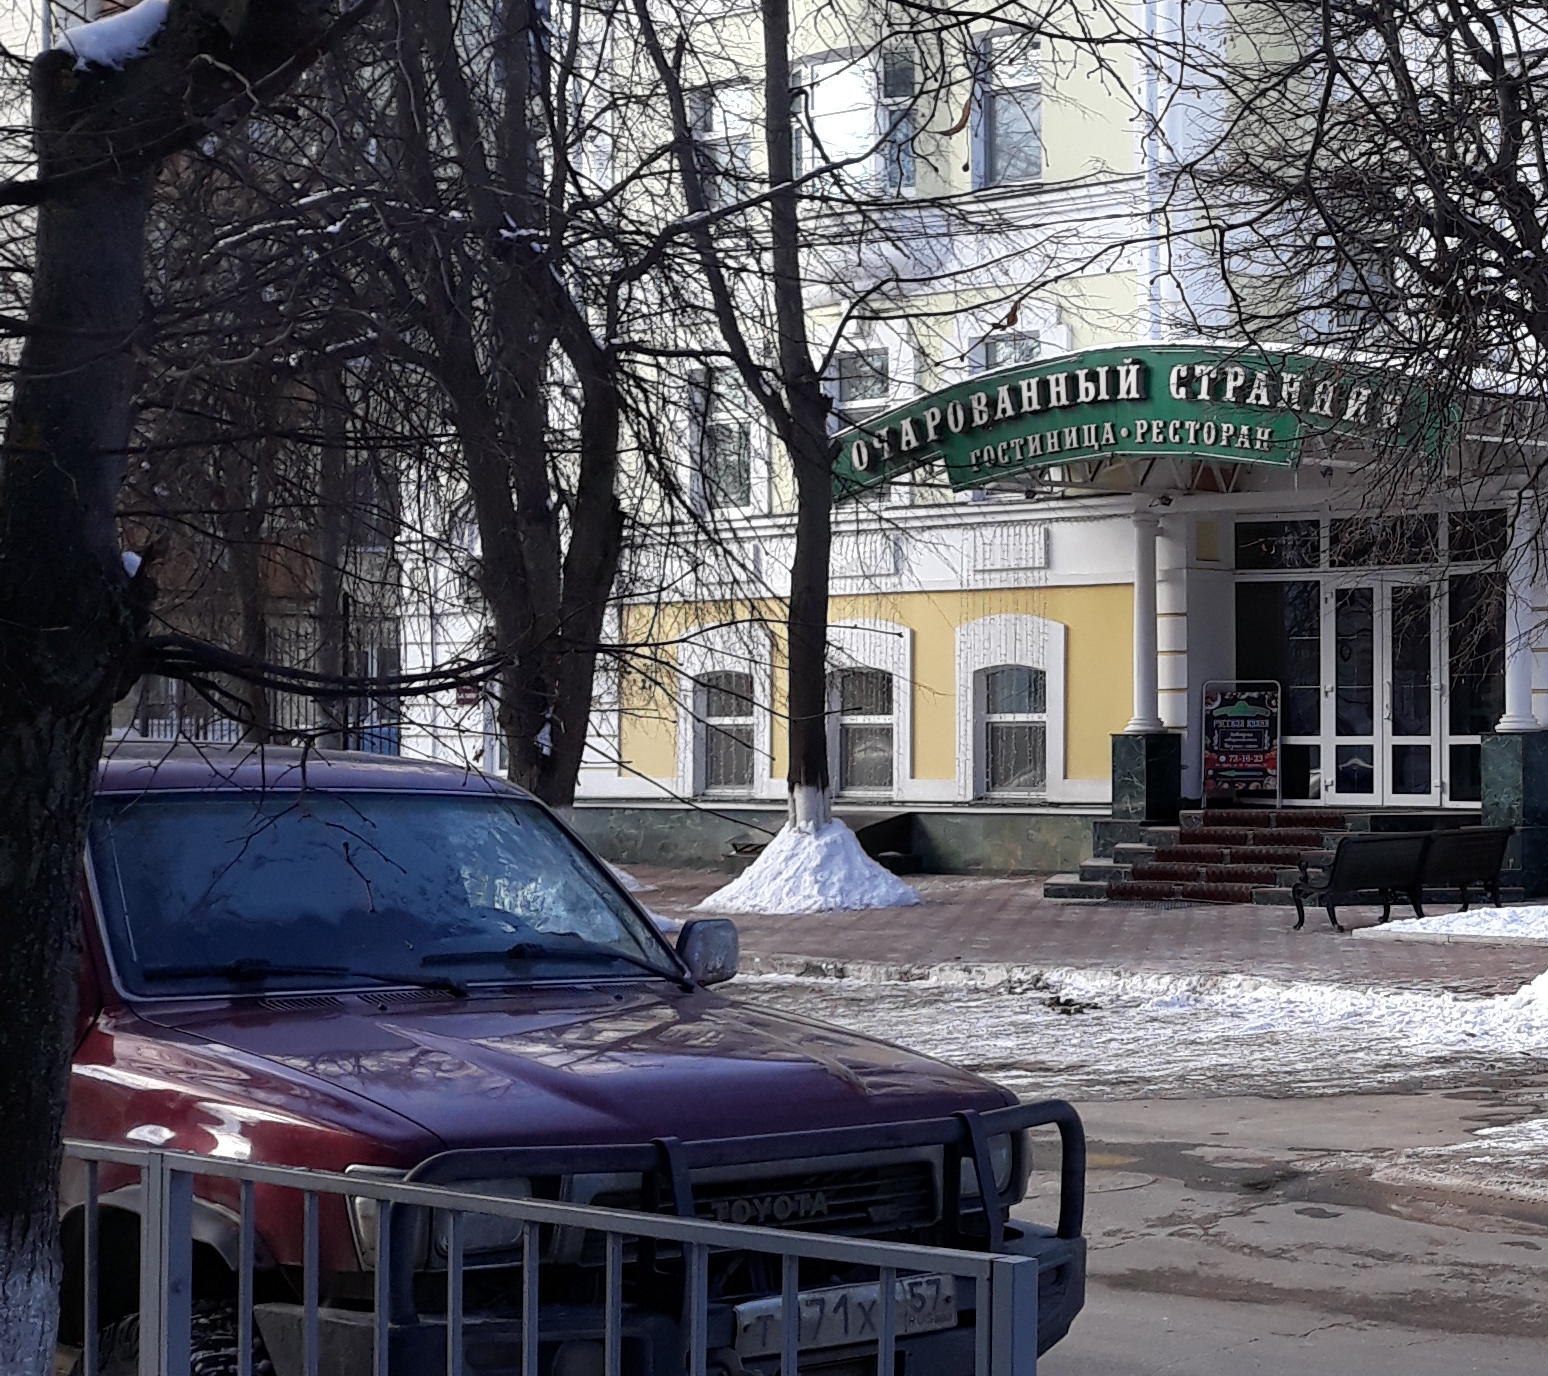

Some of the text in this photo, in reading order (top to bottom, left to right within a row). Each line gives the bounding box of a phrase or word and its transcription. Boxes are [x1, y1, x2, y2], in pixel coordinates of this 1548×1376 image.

[851, 357, 1141, 471] ОЧАРОВАННЫЙ
[969, 419, 1275, 472] ГОСТИНИЦА РЕСТОРАН
[711, 1191, 829, 1223] TOYOTA
